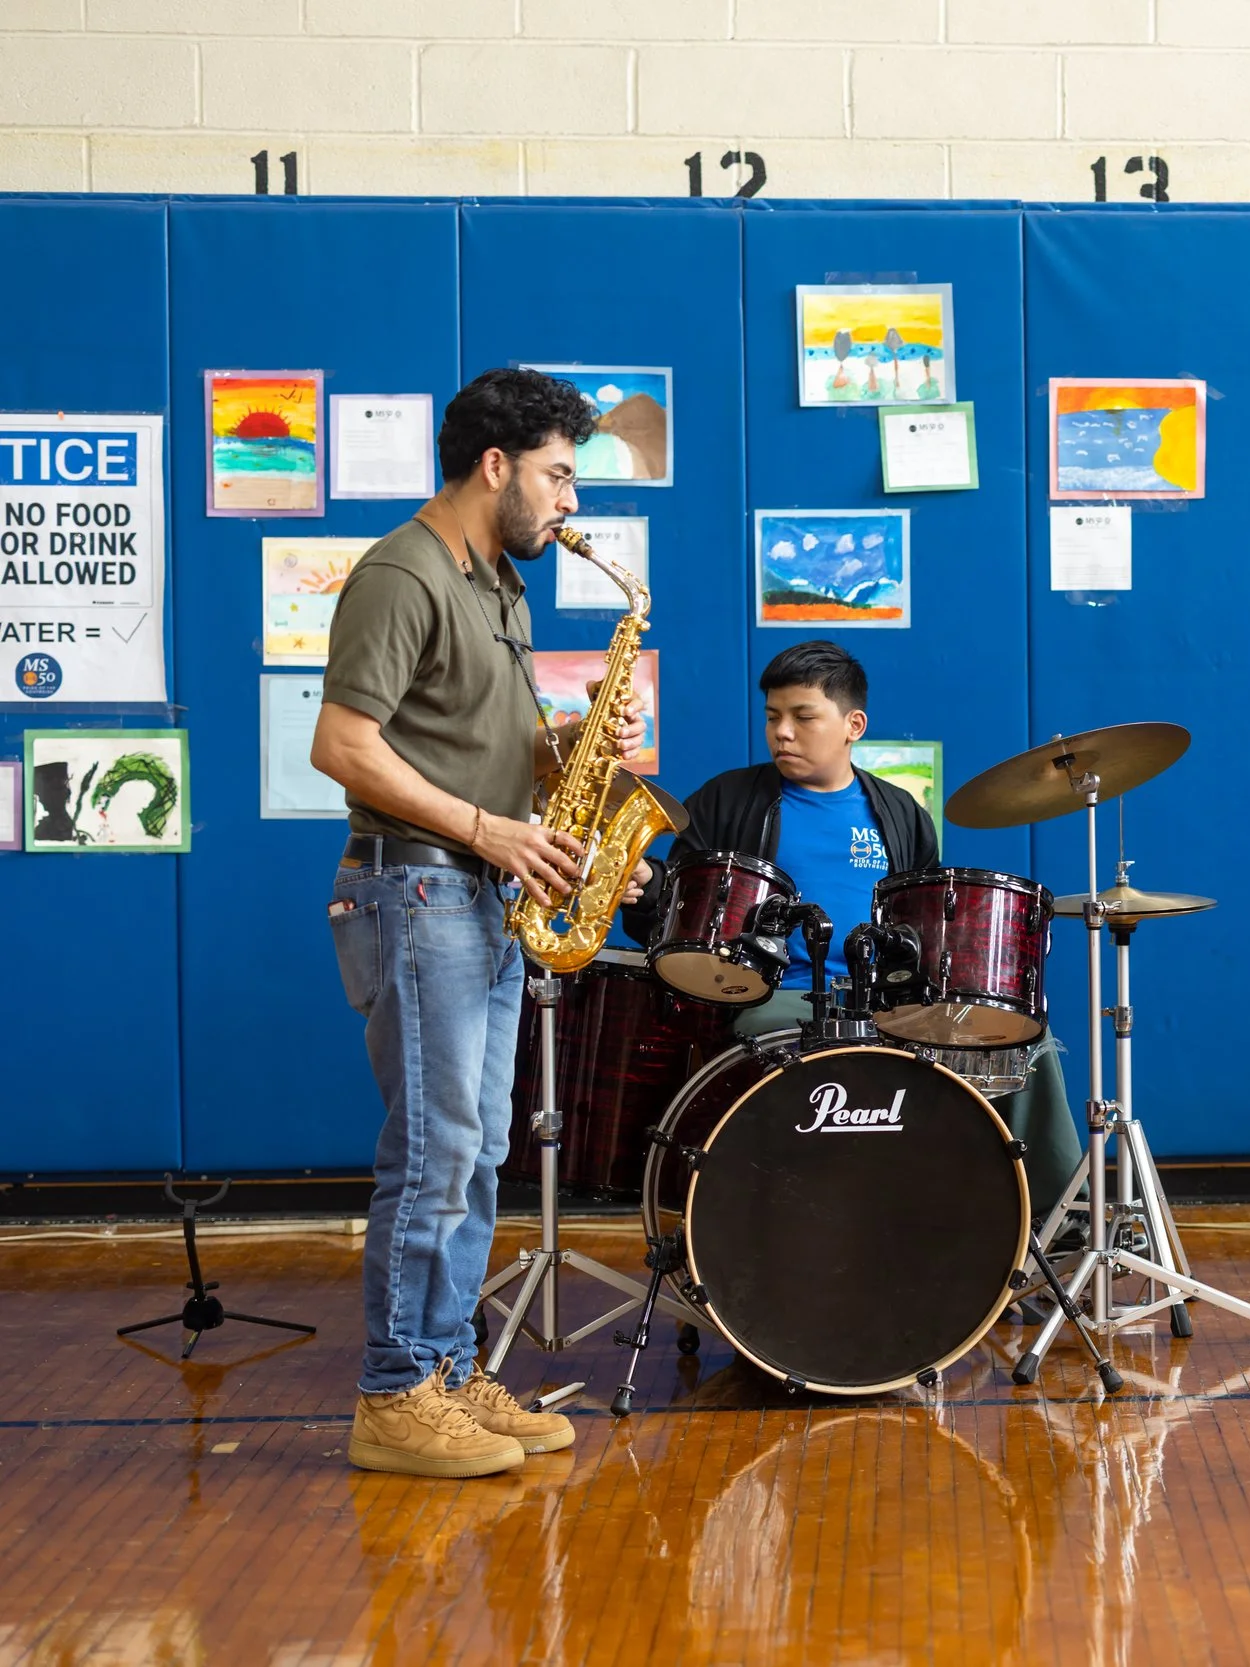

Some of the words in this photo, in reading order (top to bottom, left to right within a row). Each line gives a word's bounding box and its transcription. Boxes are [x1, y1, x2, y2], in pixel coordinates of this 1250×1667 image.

[250, 150, 298, 195] 11
[684, 150, 768, 198] 12
[1090, 155, 1170, 202] 13
[5, 502, 46, 526] NO
[56, 503, 131, 527] FOOD
[0, 531, 39, 556] OR
[49, 532, 137, 556] DRINK
[1, 561, 136, 585] ALLOWED
[0, 622, 76, 643] ATER
[23, 658, 49, 672] MS
[37, 672, 56, 686] 50
[850, 826, 880, 842] MS
[795, 1083, 906, 1132] Pearl
